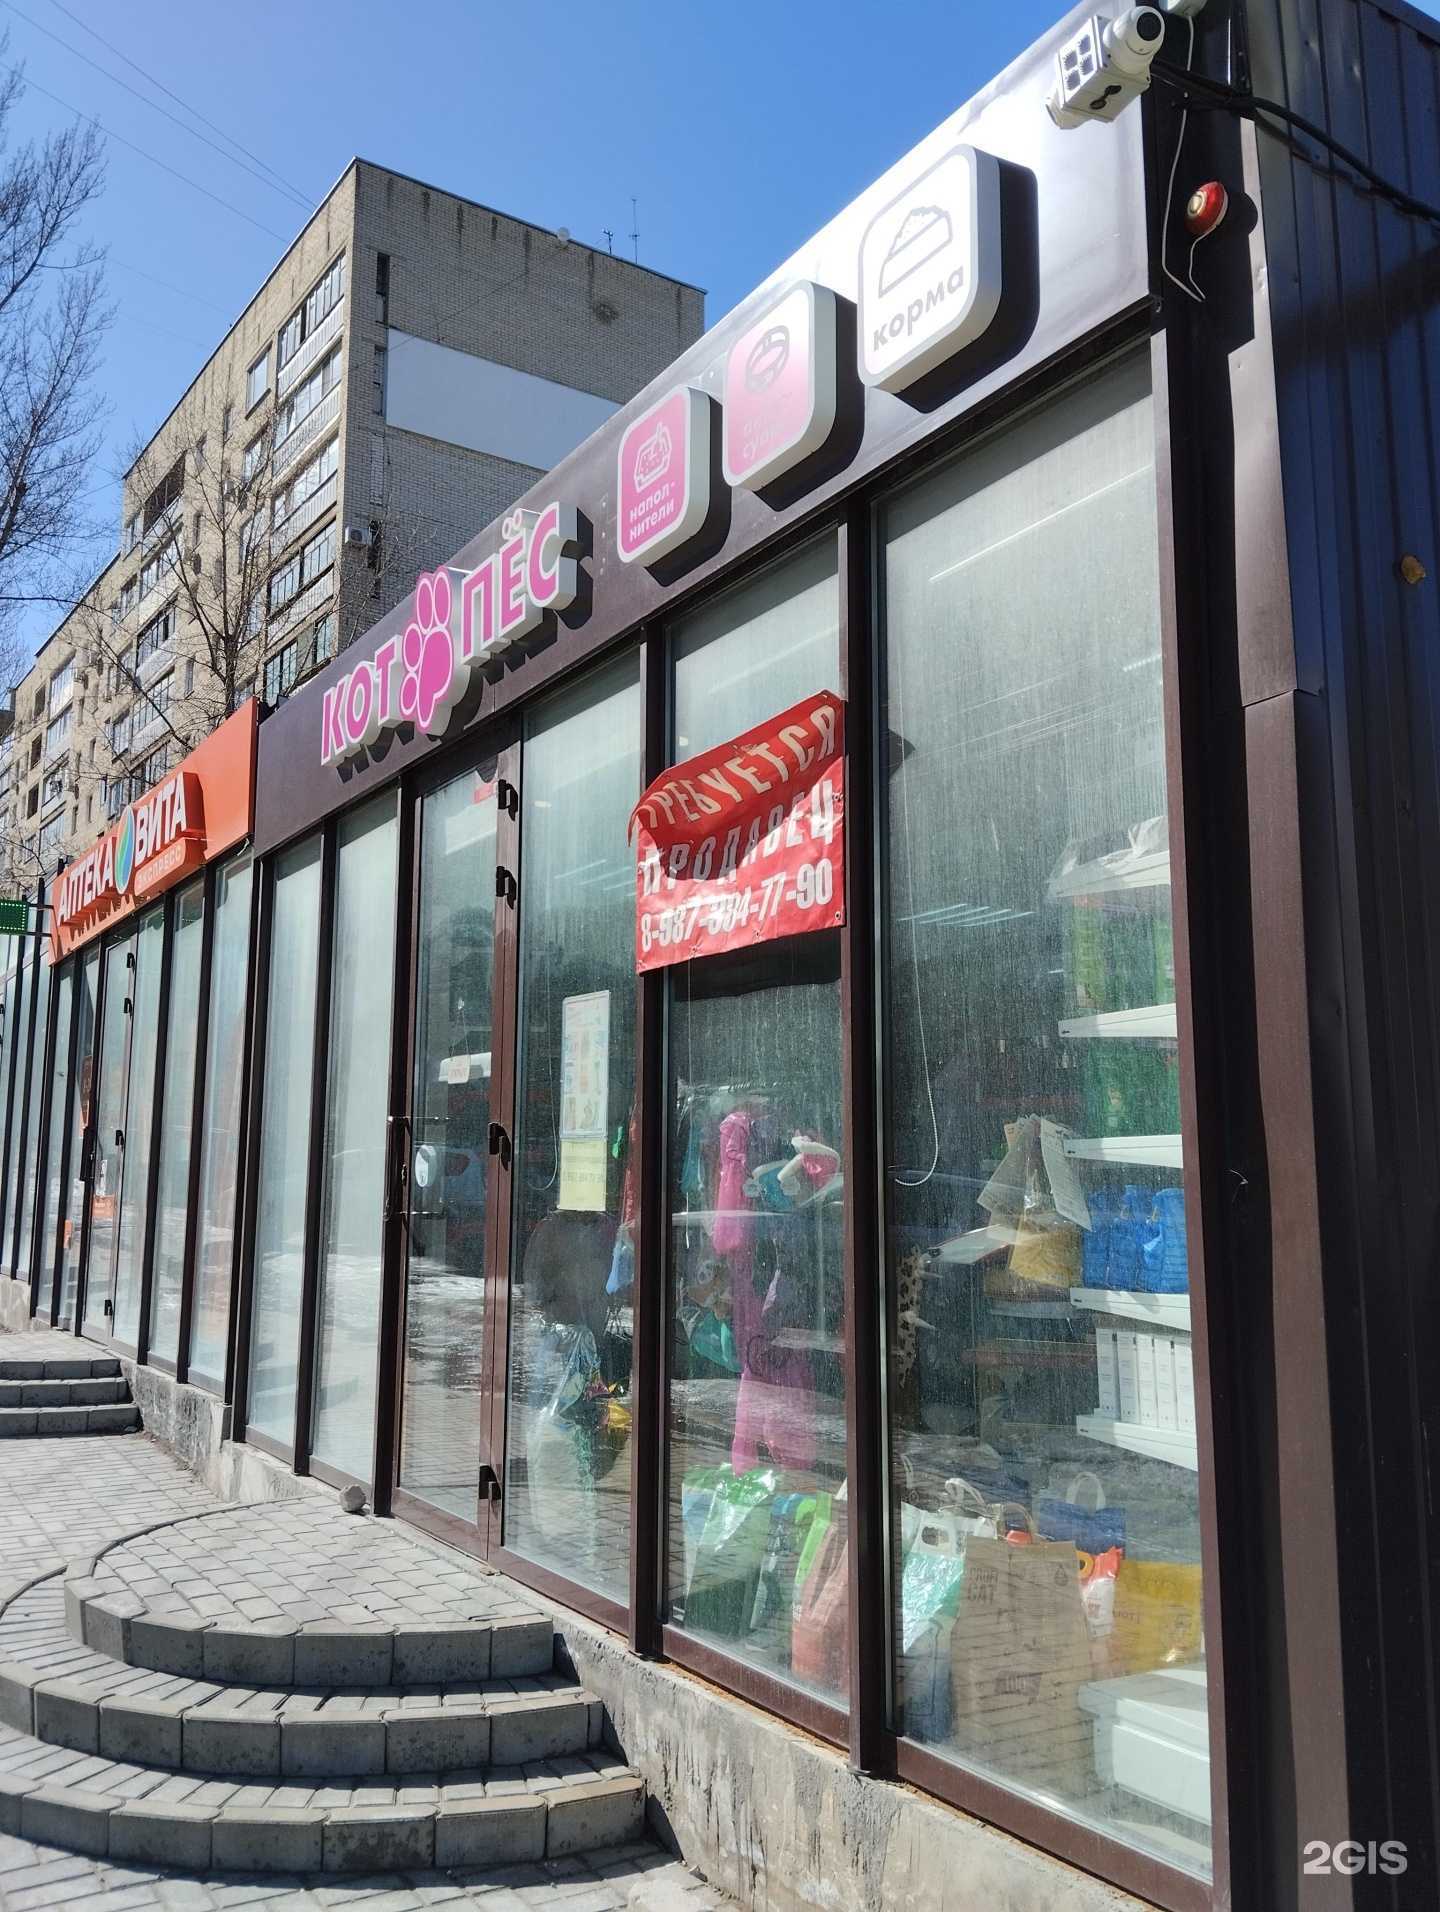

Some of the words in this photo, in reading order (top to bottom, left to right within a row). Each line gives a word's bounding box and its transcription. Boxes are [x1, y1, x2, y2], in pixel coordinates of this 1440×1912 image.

[874, 265, 963, 352] корма
[629, 481, 676, 522] напол-
[629, 498, 675, 543] нители
[320, 634, 400, 766] КОТ
[461, 502, 560, 660] ПЁС
[57, 836, 115, 926] АПТЕКА
[135, 773, 187, 867] ВИТА
